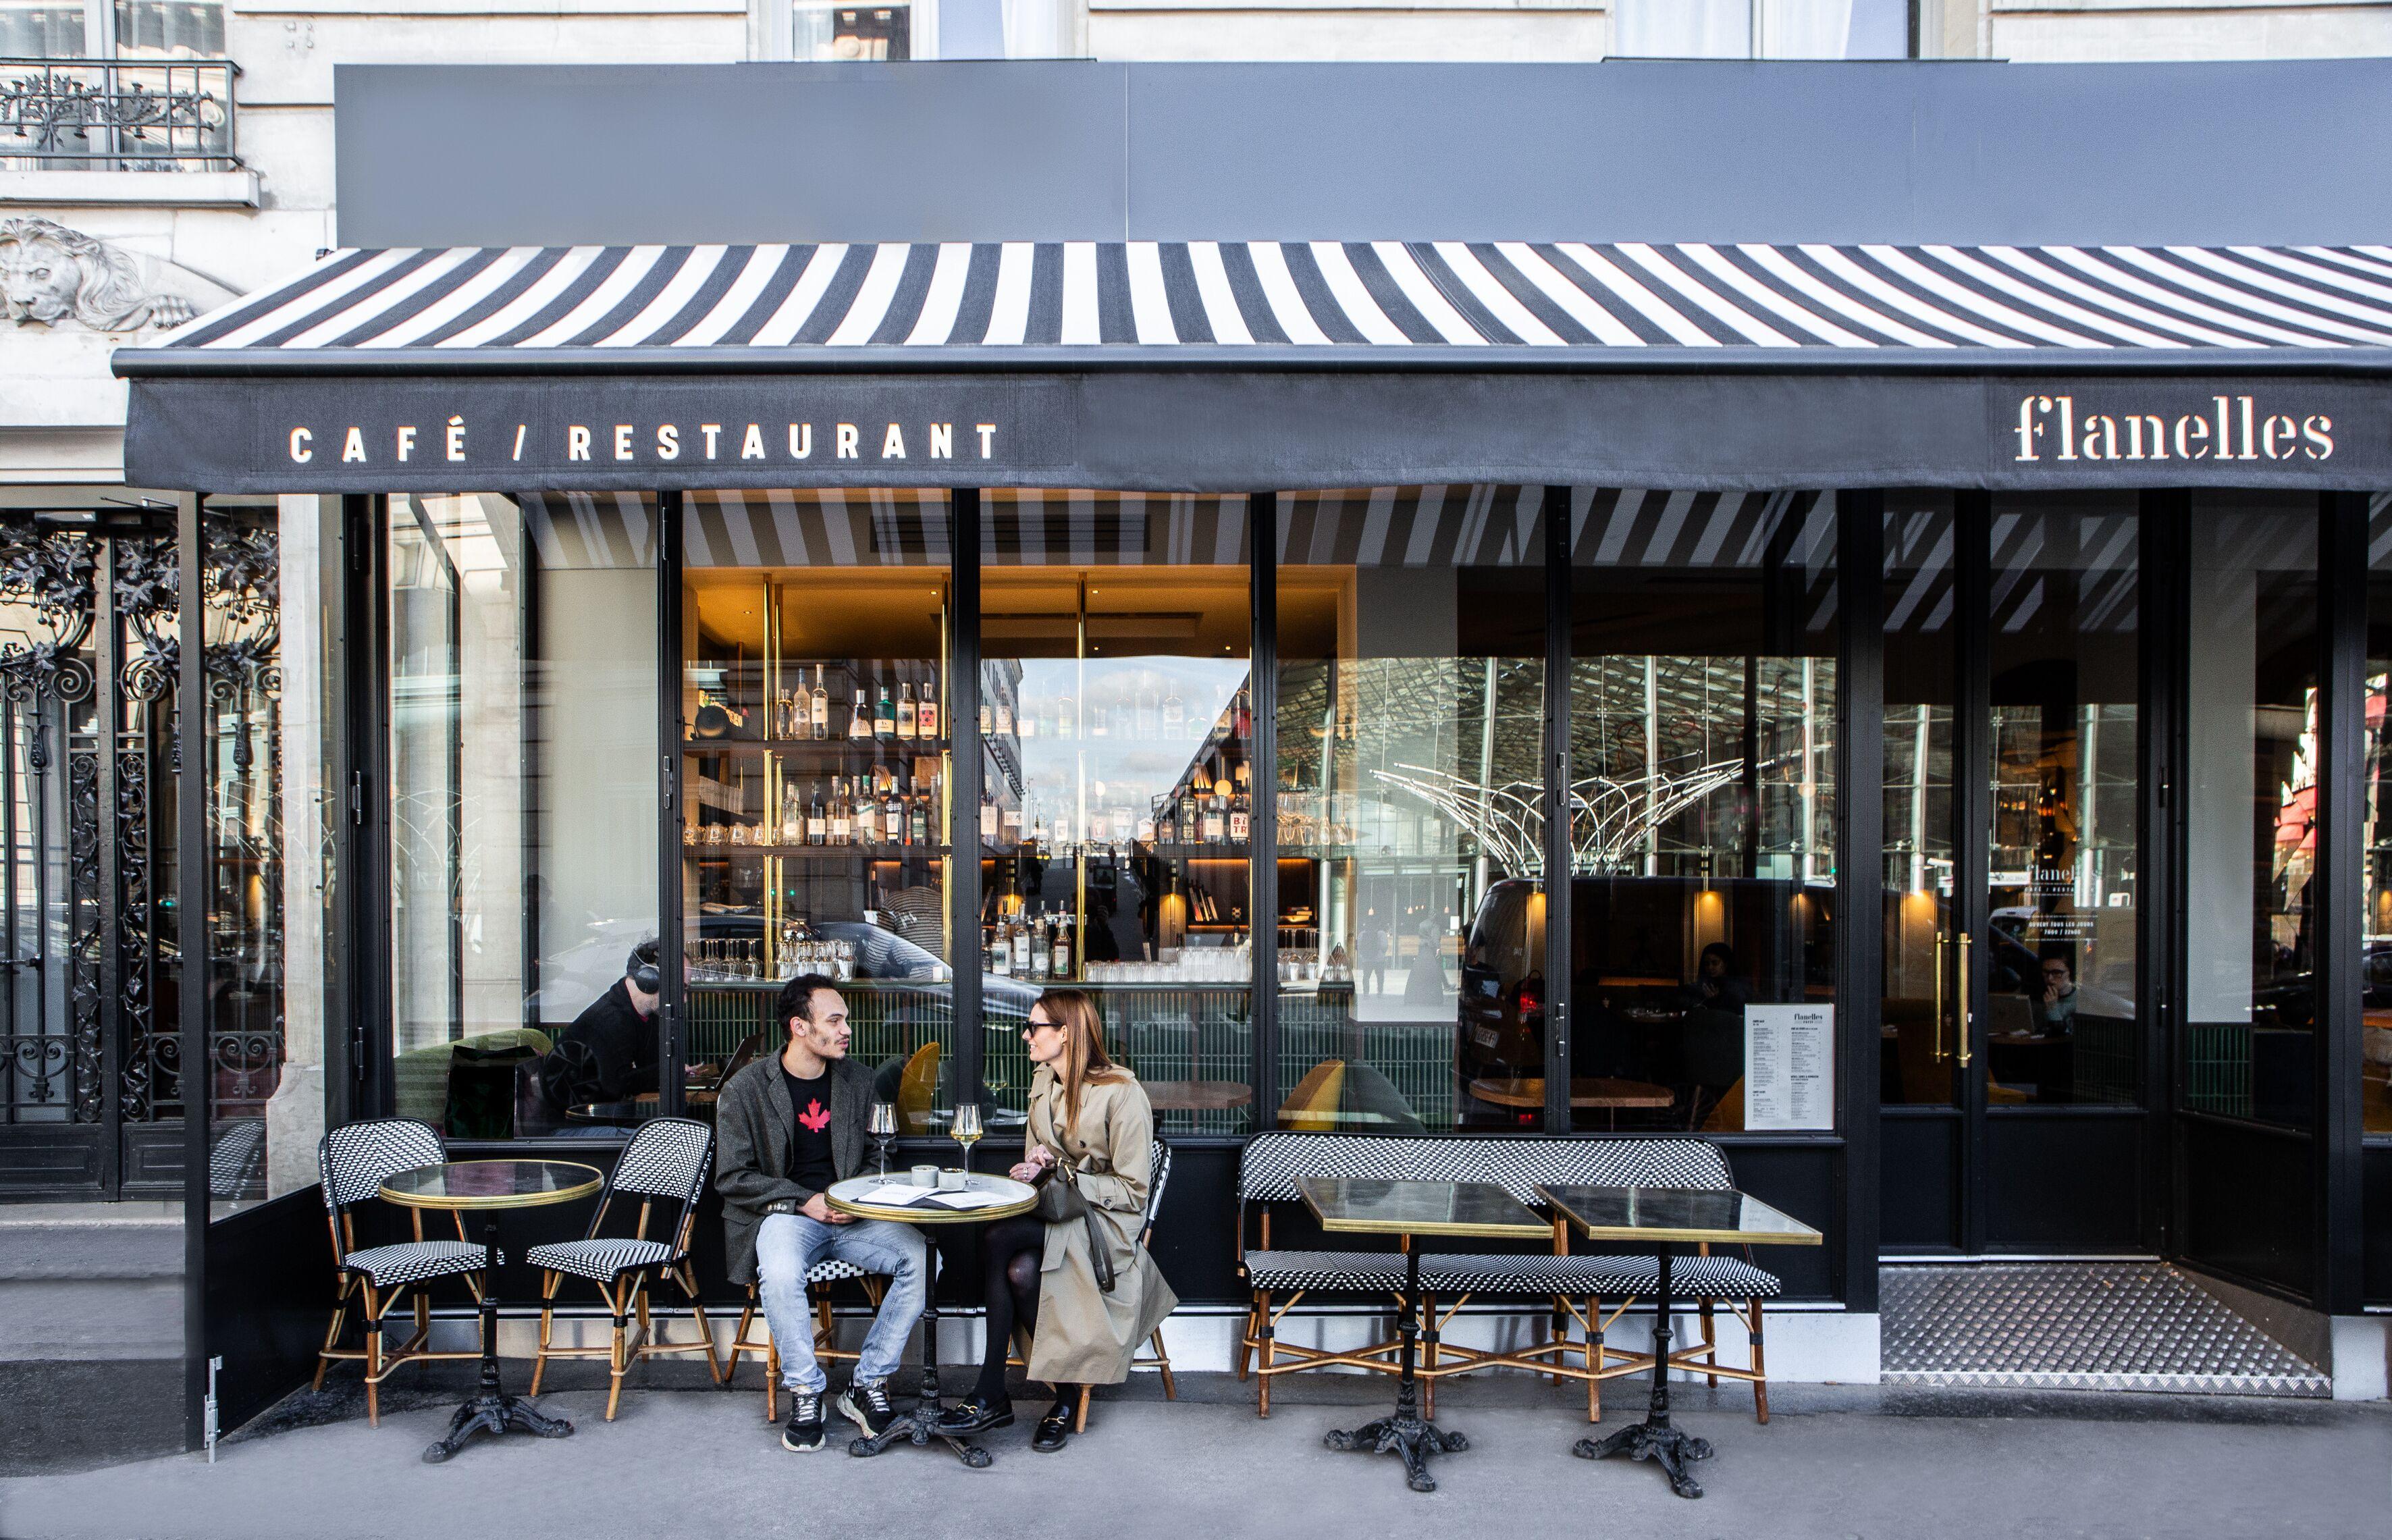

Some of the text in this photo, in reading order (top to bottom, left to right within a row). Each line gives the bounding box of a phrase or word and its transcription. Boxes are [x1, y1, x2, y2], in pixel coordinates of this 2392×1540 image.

[289, 414, 996, 464] CAFÉ / RESTAURANT
[2014, 395, 2335, 461] flanelles
[2026, 864, 2099, 881] flanels
